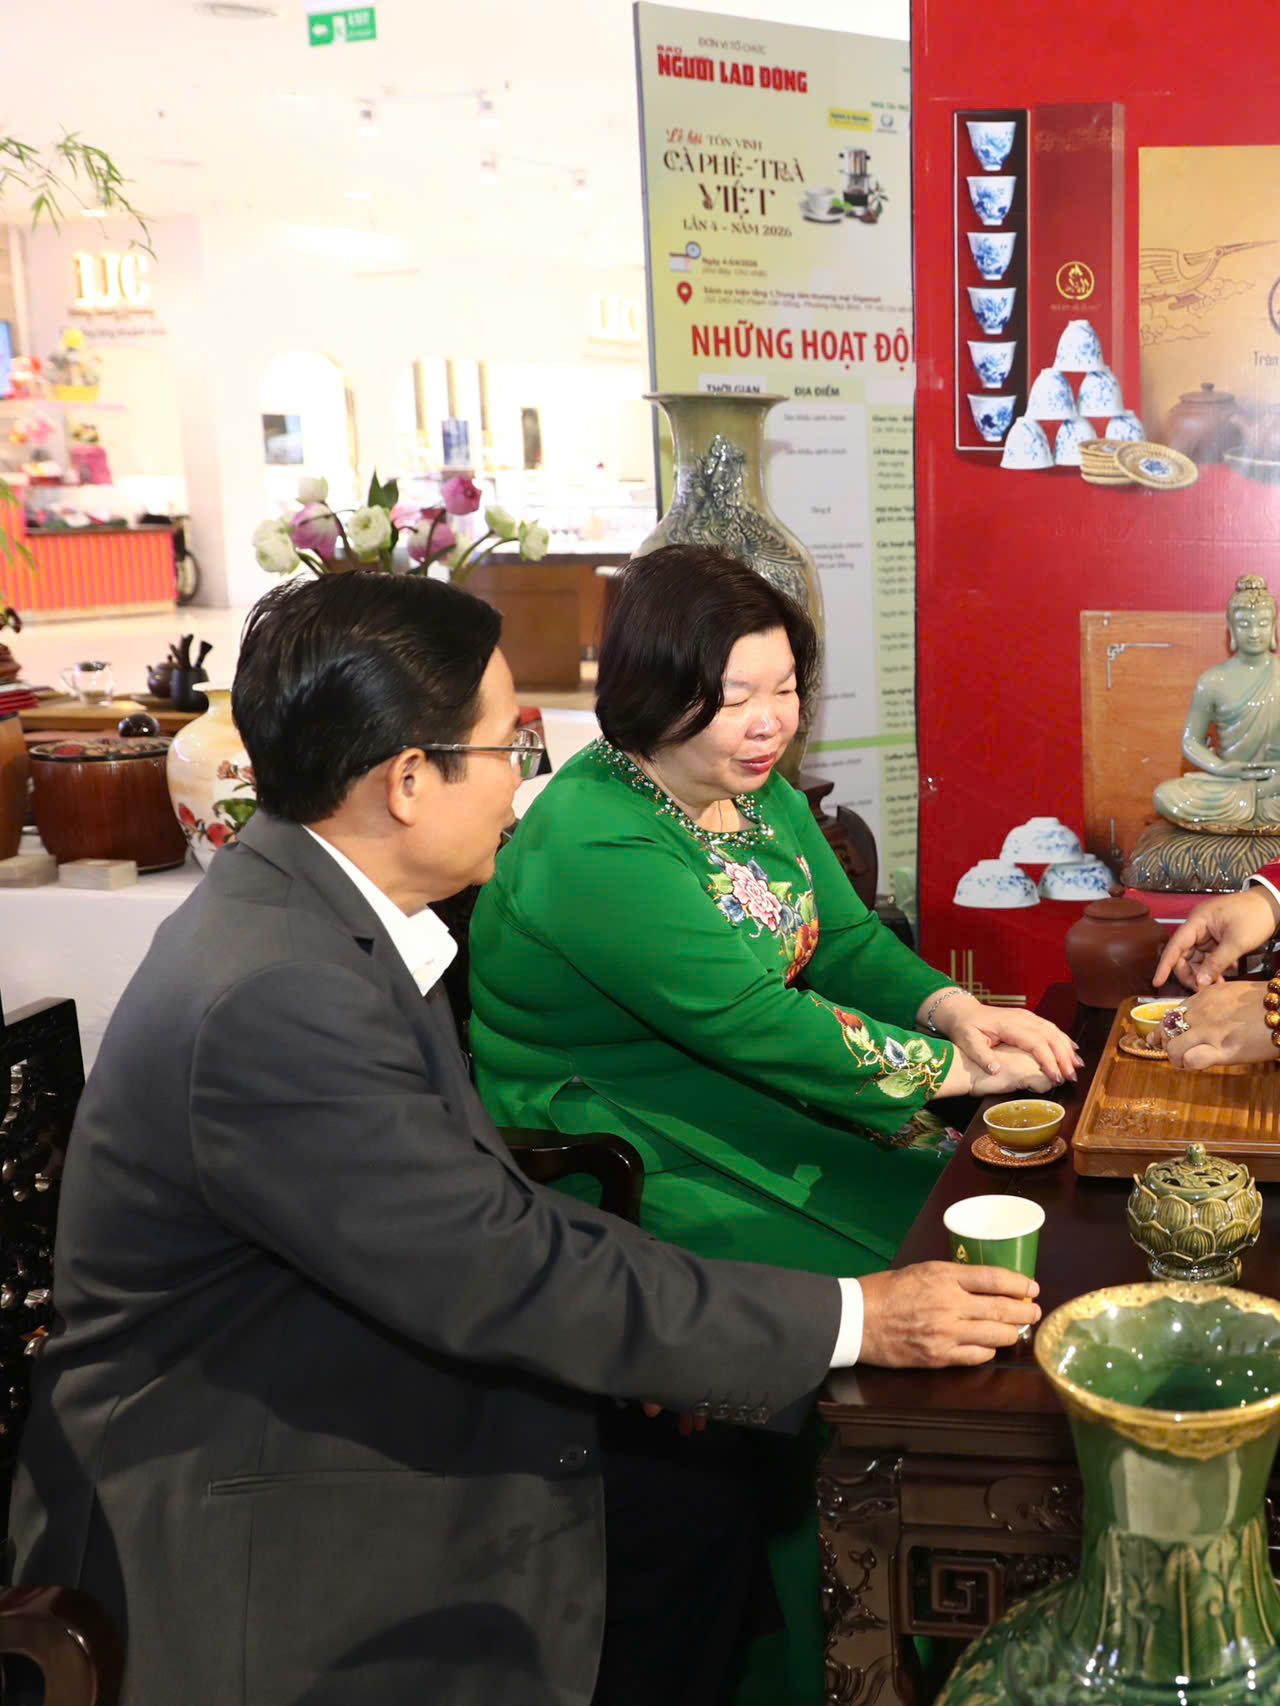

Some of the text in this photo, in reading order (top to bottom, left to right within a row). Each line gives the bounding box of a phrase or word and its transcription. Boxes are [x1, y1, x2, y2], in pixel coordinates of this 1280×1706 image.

[720, 60, 754, 87] LAO
[734, 137, 762, 151] VINH
[663, 146, 695, 174] CÀ
[698, 179, 776, 219] VIỆT
[763, 224, 792, 238] 2026
[691, 320, 915, 371] NHỮNG HOẠT ĐỘ
[814, 385, 840, 397] ĐIỂM
